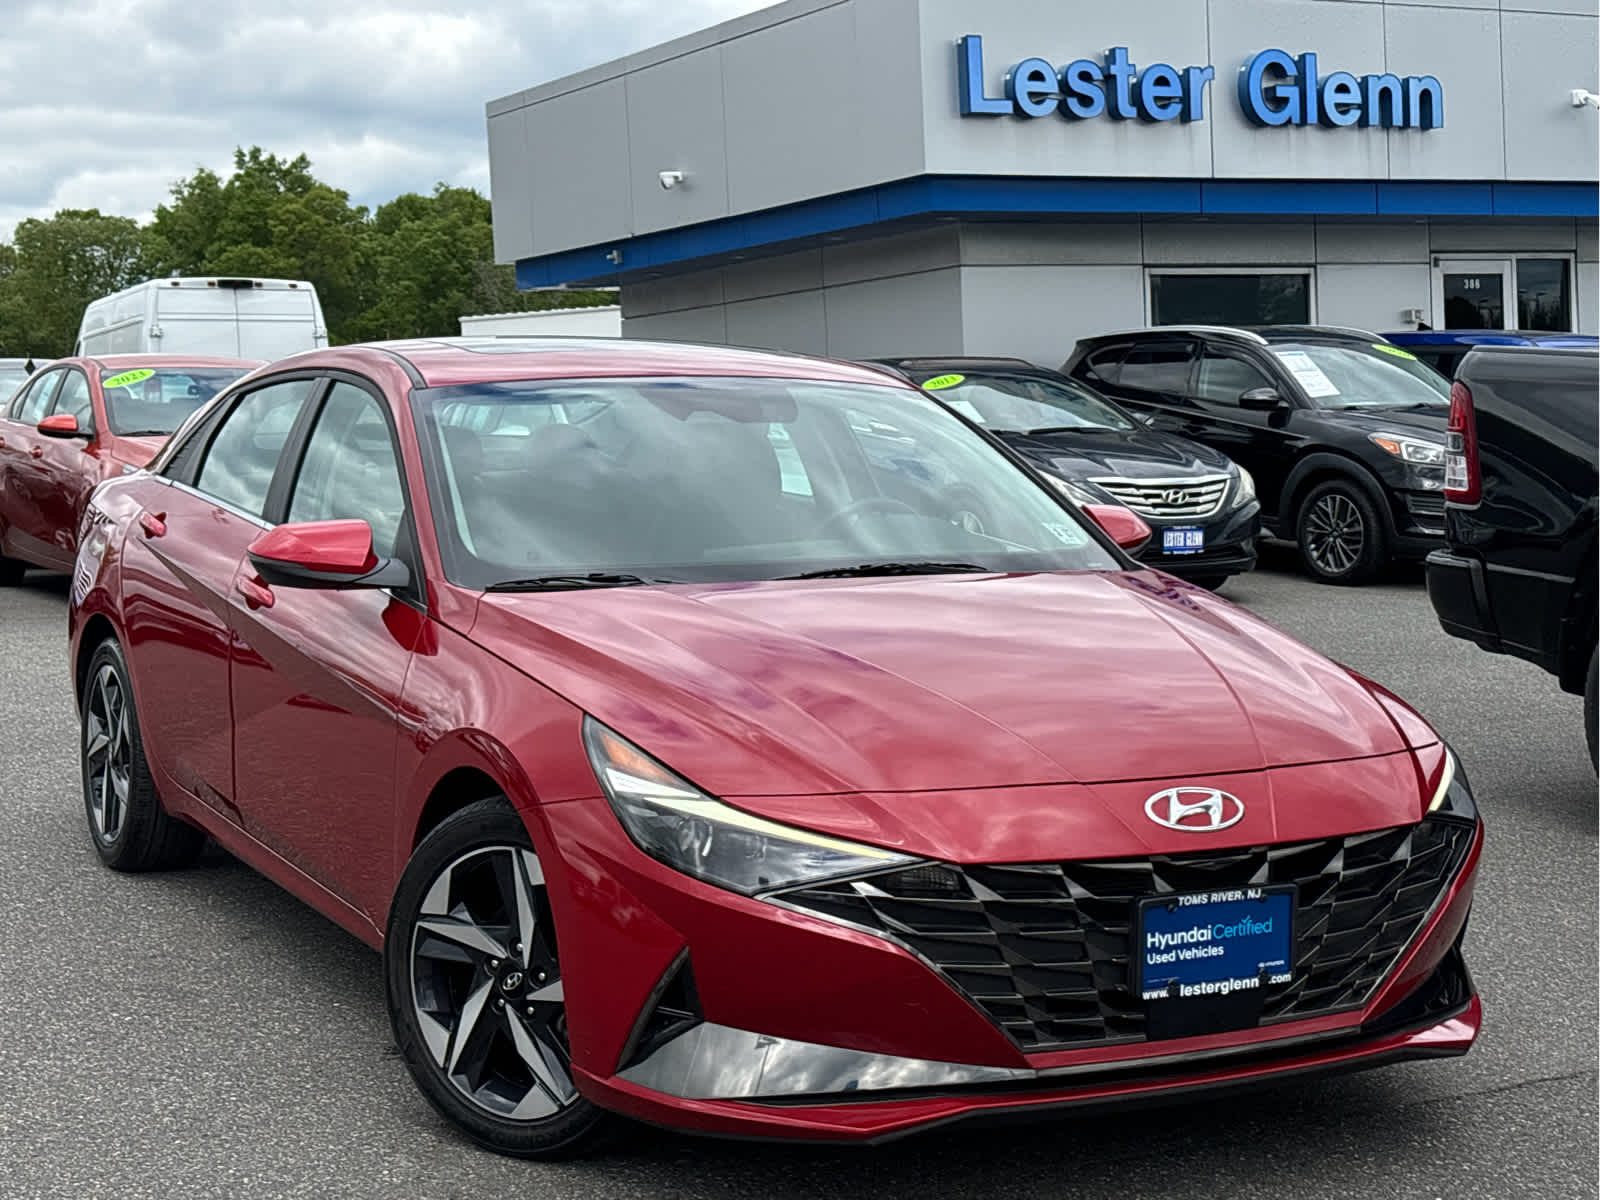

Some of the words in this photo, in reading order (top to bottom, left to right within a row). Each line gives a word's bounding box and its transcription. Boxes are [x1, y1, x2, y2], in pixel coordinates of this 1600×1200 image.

[957, 34, 1214, 122] Lester
[1239, 48, 1444, 129] Glenn
[1178, 895, 1208, 907] TOMS
[1247, 888, 1262, 899] NJ
[1146, 924, 1212, 950] Hyundai
[1213, 915, 1273, 939] Certified
[1146, 950, 1176, 965] Used
[1177, 945, 1225, 960] Vehicles
[1142, 989, 1169, 1000] www.
[1179, 977, 1259, 997] lesterglenn
[1268, 972, 1292, 985] .com
